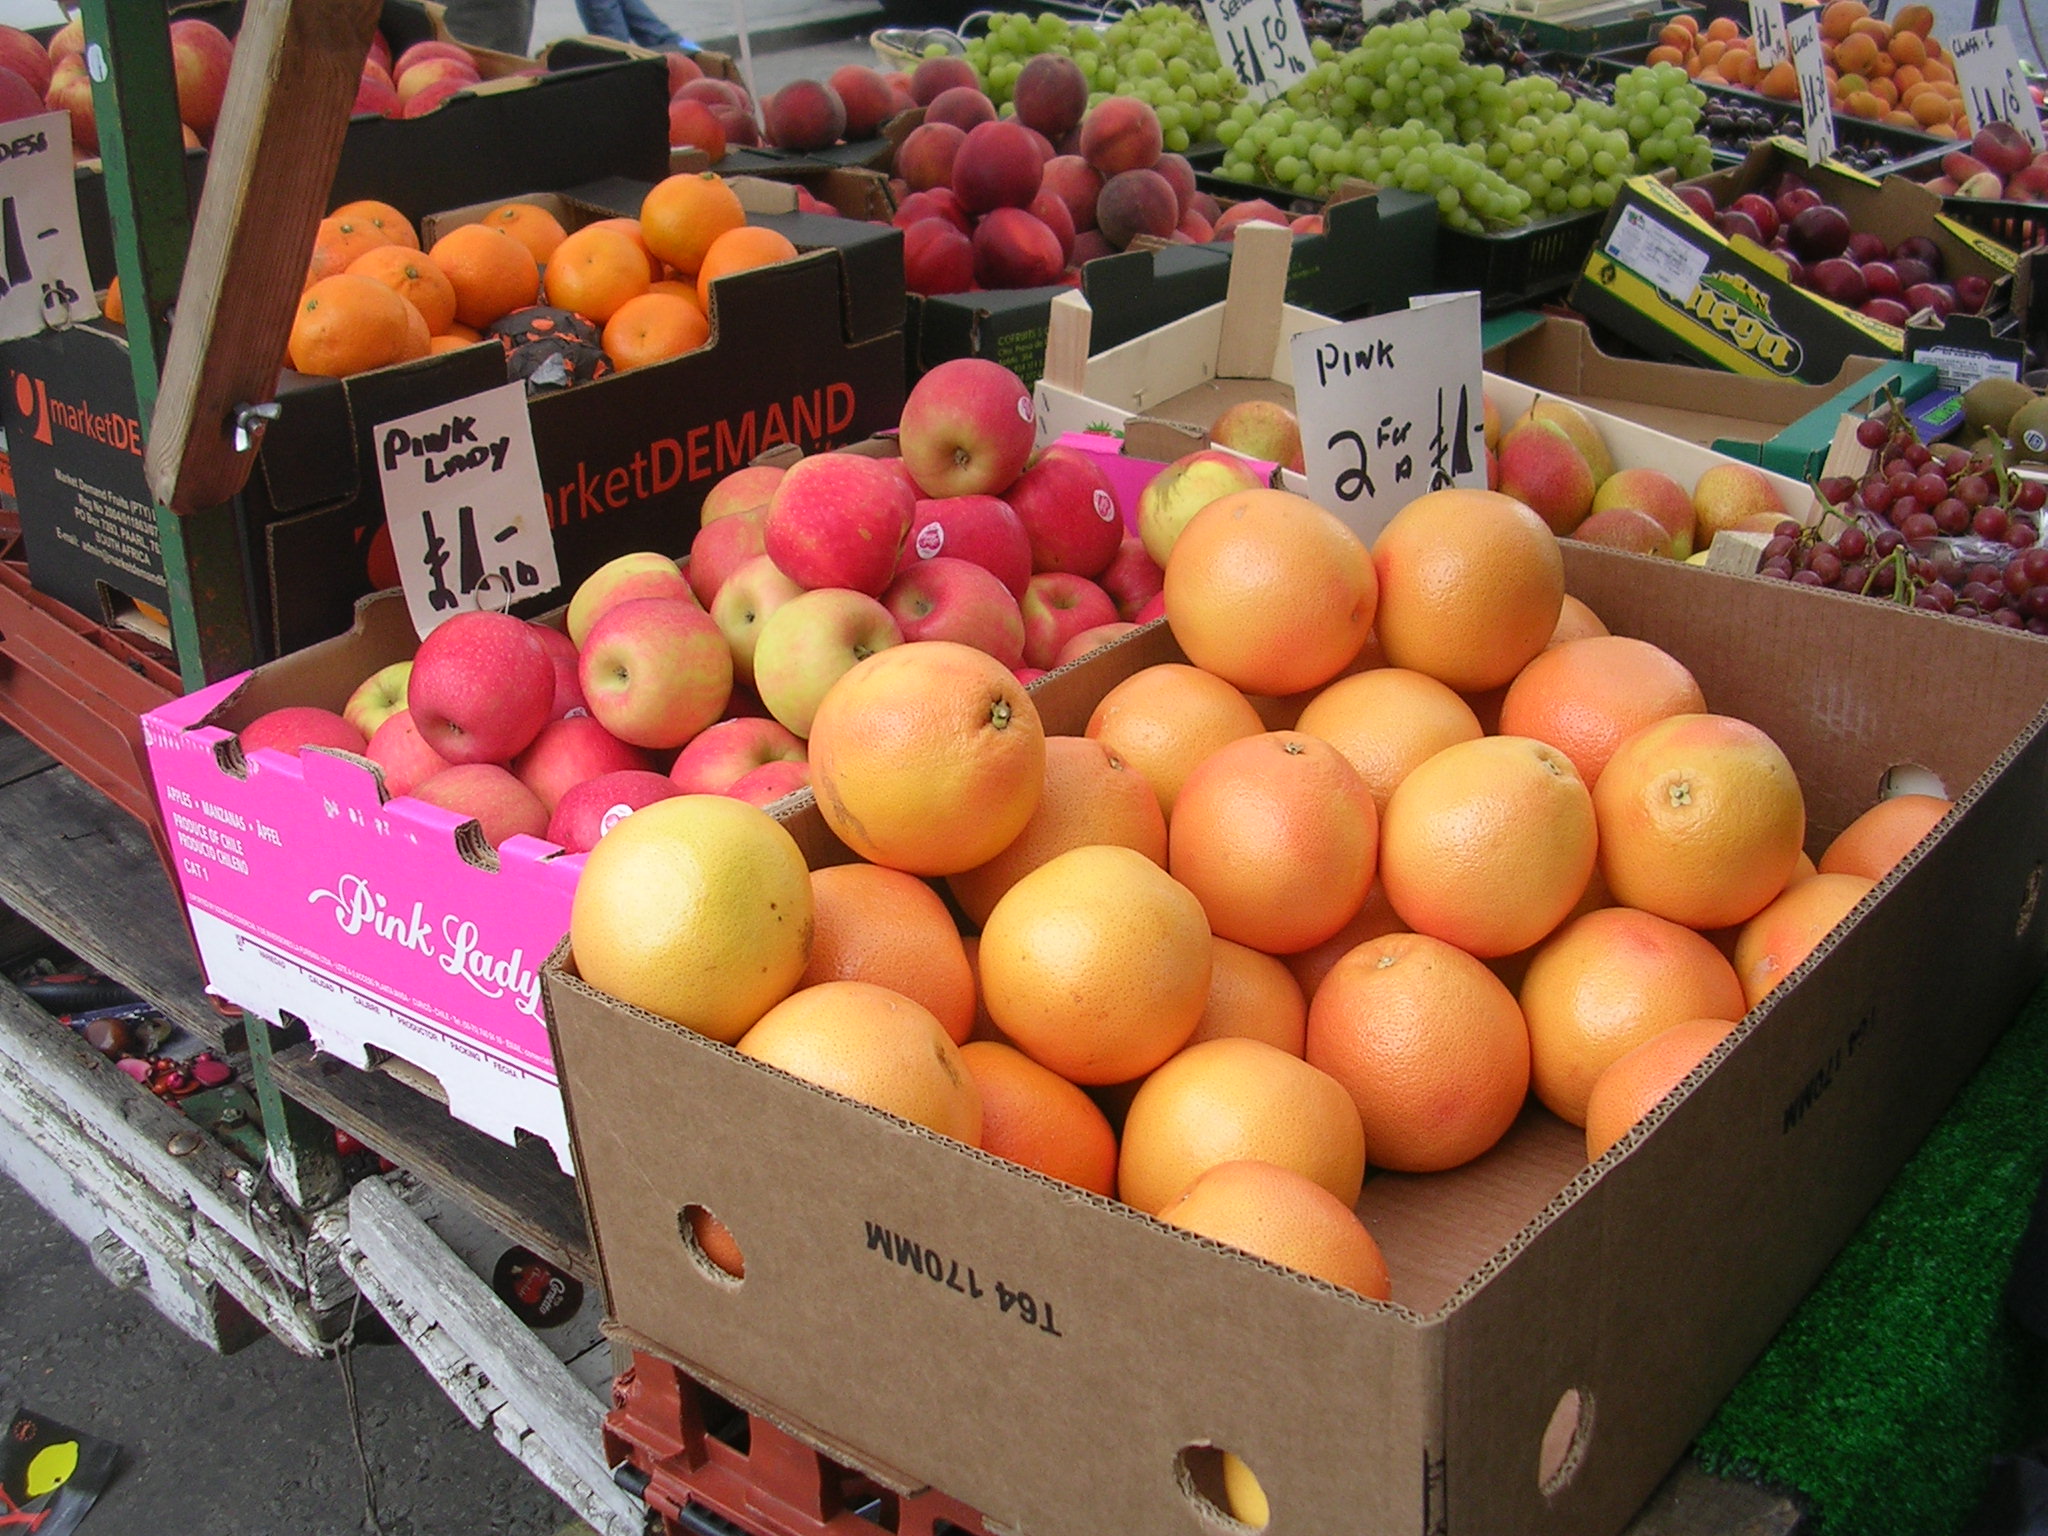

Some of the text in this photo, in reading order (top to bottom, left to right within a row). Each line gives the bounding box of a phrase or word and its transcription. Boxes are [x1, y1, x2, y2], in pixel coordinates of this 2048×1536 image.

[50, 397, 143, 457] marketDE
[543, 382, 857, 531] rketDEMAND
[1327, 430, 1376, 502] 2
[166, 784, 193, 810] APPLES
[201, 799, 248, 833] MANZANAS
[172, 811, 245, 857] PRODUCE OF CHILE
[183, 858, 202, 879] CAT
[307, 873, 547, 1028] Pink Lady
[864, 1220, 1063, 1338] T64 170MM
